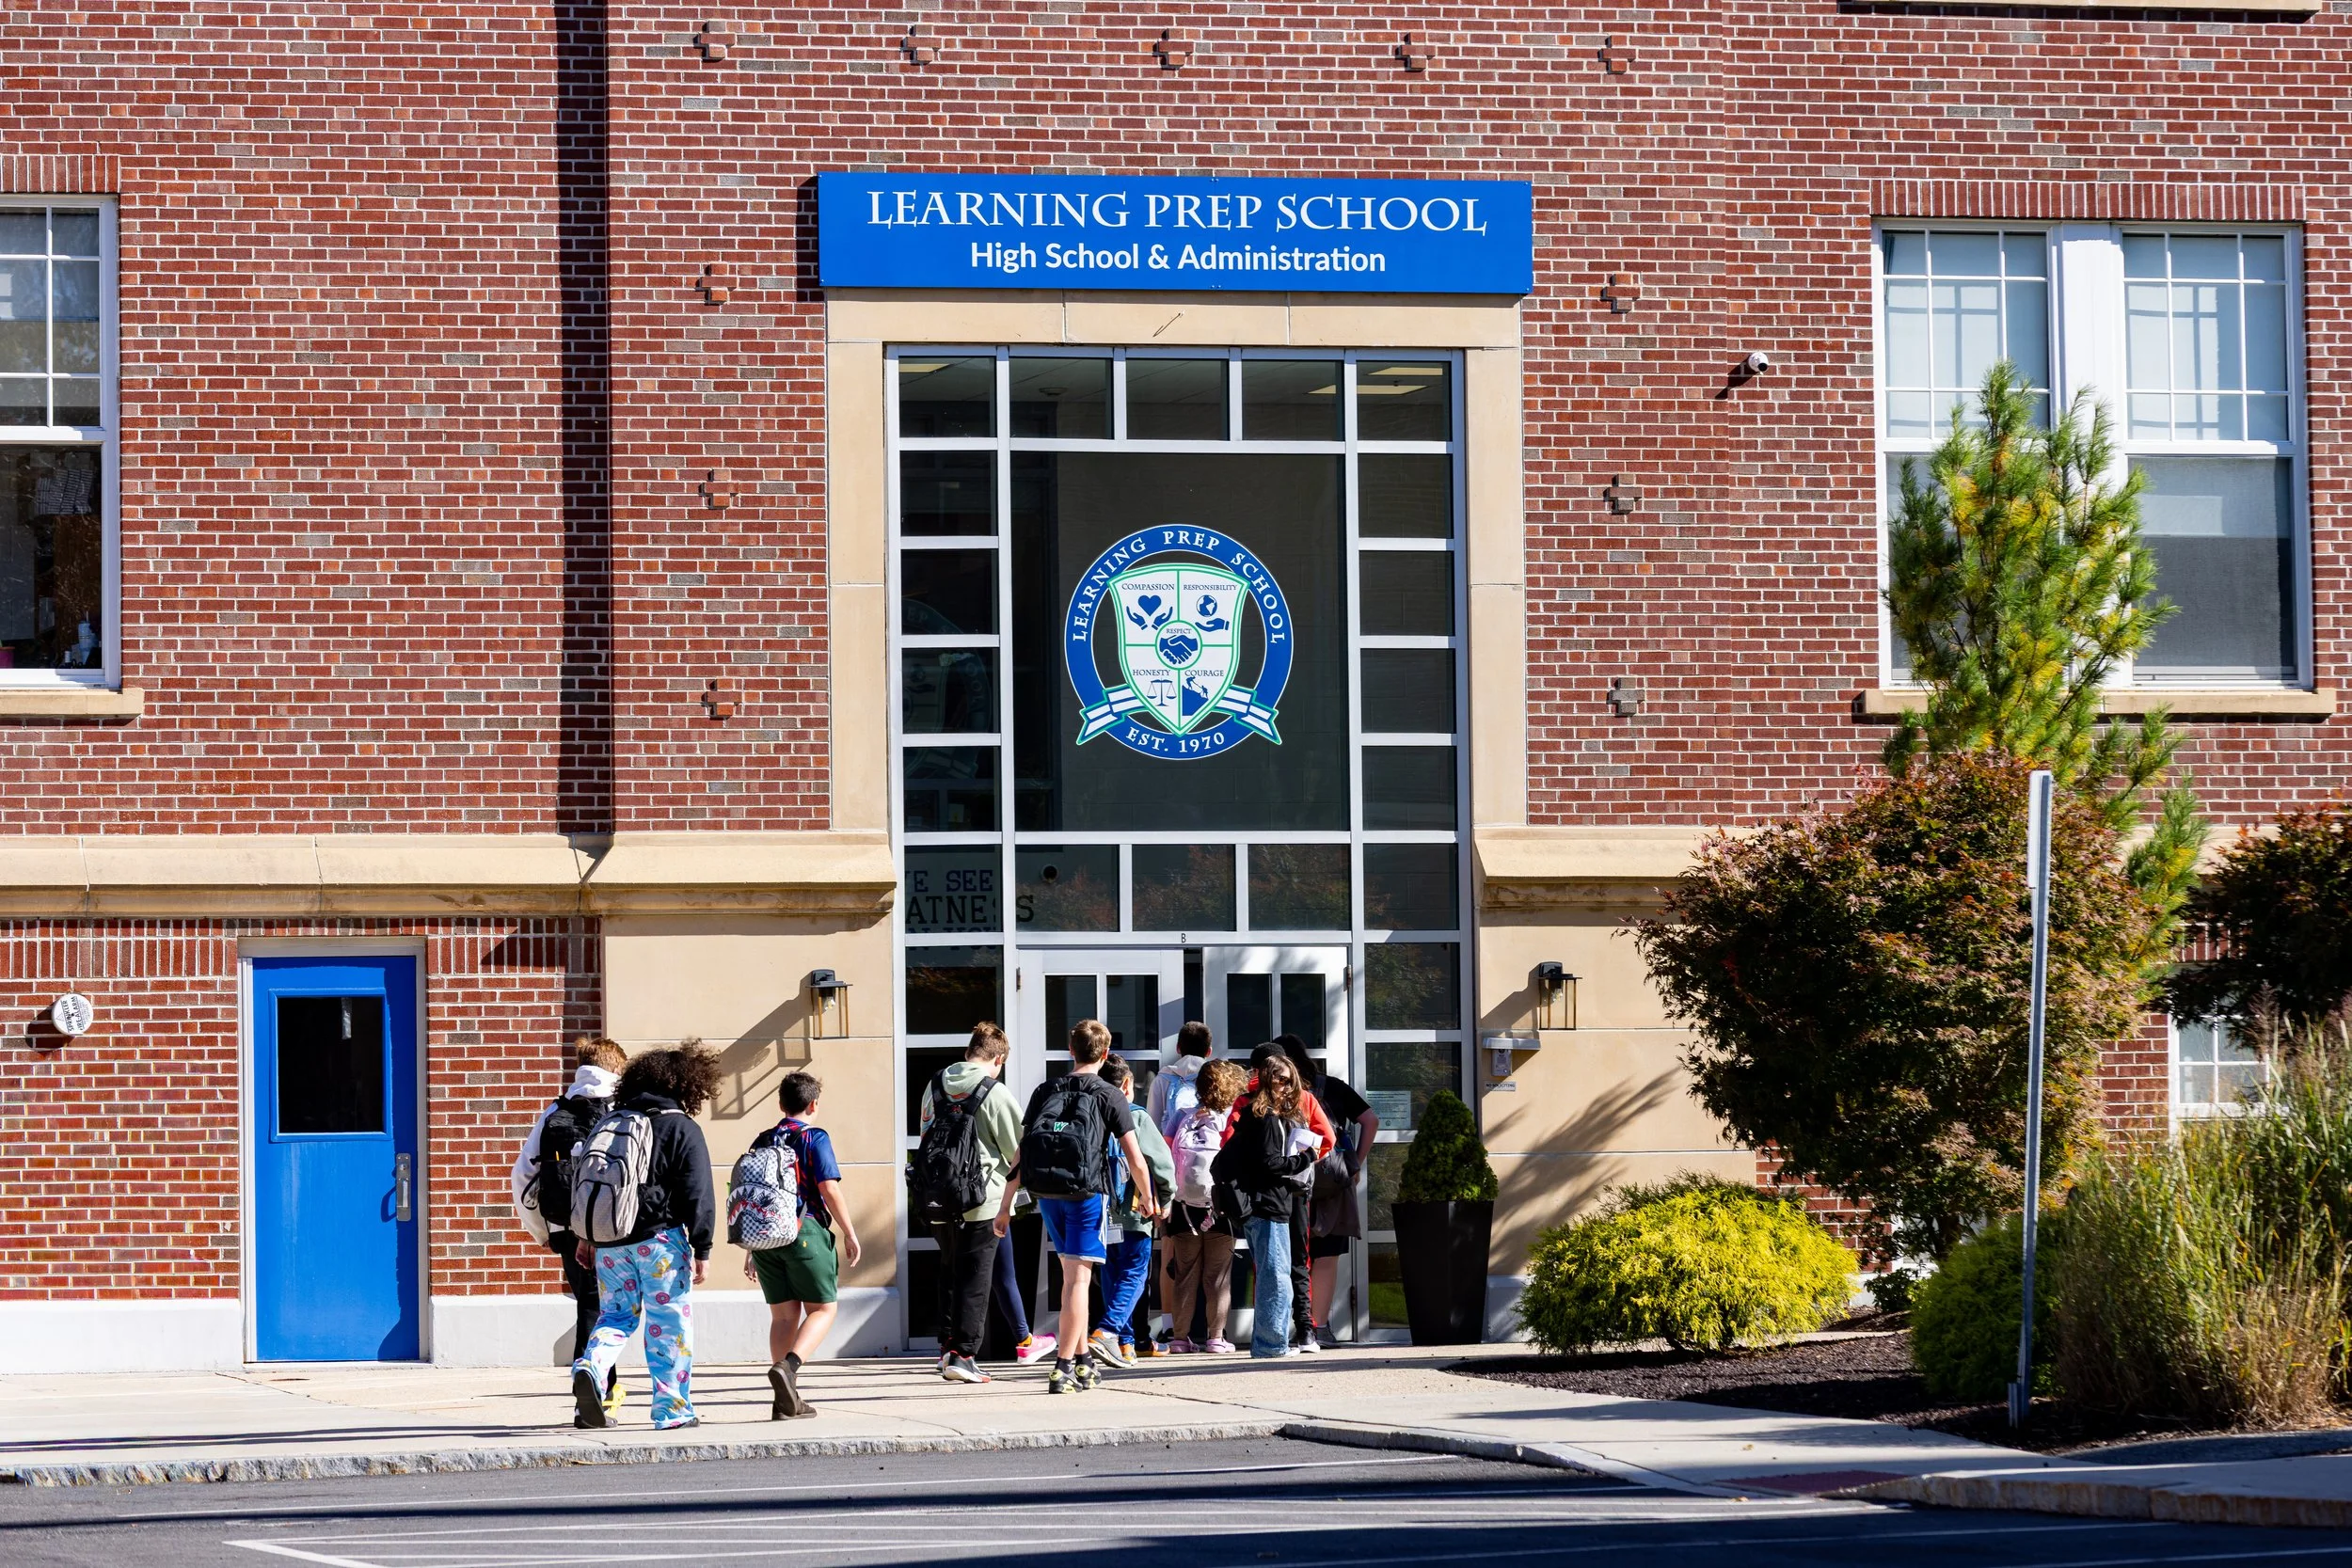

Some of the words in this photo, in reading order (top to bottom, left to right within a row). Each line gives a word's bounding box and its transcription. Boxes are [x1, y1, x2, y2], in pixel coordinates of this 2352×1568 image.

[867, 190, 1131, 230] LEARNING
[1144, 194, 1263, 231] PREP
[1276, 194, 1487, 236] SCHOOL
[971, 242, 1037, 274] High
[1045, 242, 1139, 269] School
[1147, 244, 1170, 270] &
[1178, 244, 1386, 272] Administration
[1073, 537, 1146, 641] LEARNING
[1163, 531, 1220, 551] PREP
[1231, 553, 1285, 644] SCHOOL
[1121, 582, 1175, 591] COMPASSION
[1132, 669, 1171, 677] HONESTY
[1184, 669, 1225, 677] COURAGE
[1126, 726, 1168, 752] EST.
[1179, 732, 1225, 752] 1970
[905, 870, 929, 893] E
[946, 869, 993, 893] SEE
[905, 895, 1034, 925] ATNES
[1181, 932, 1186, 943] B
[62, 1000, 74, 1032] SPRINKLER
[1054, 1121, 1069, 1132] W
